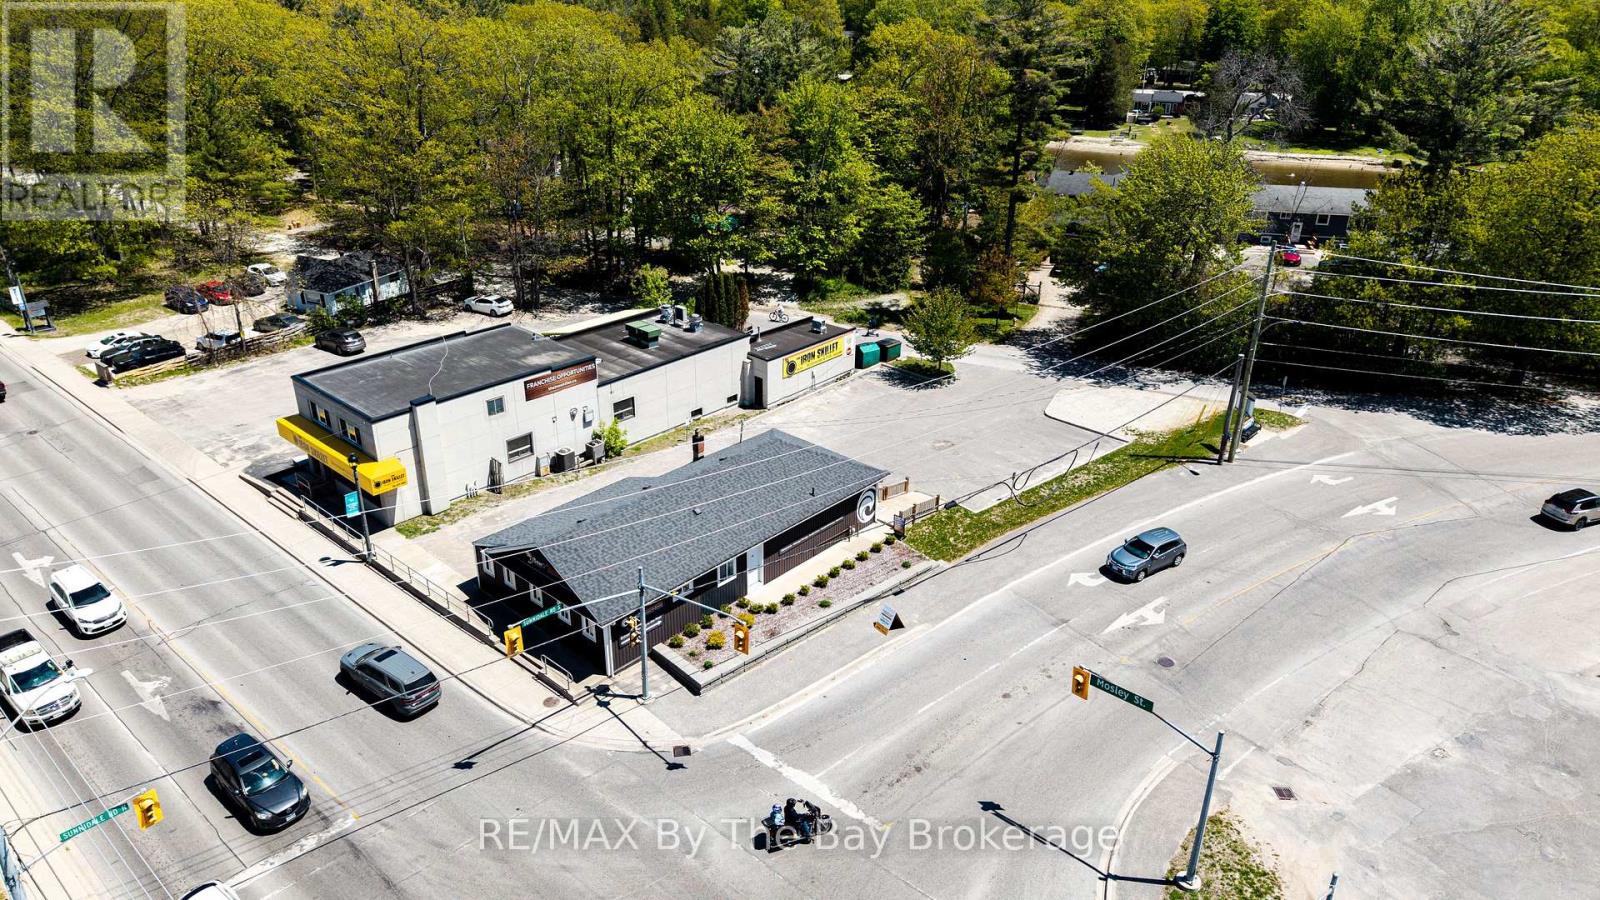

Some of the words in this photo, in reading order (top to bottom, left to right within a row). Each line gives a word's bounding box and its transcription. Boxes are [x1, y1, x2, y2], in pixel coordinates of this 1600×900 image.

[800, 350, 816, 365] IRON
[817, 341, 839, 356] SKILLET
[526, 375, 557, 390] FRANCHISE
[556, 363, 595, 380] OPPORTUNITIES
[1096, 678, 1130, 700] Mosley
[1133, 696, 1146, 708] St.
[63, 815, 106, 839] SUNNIDALE
